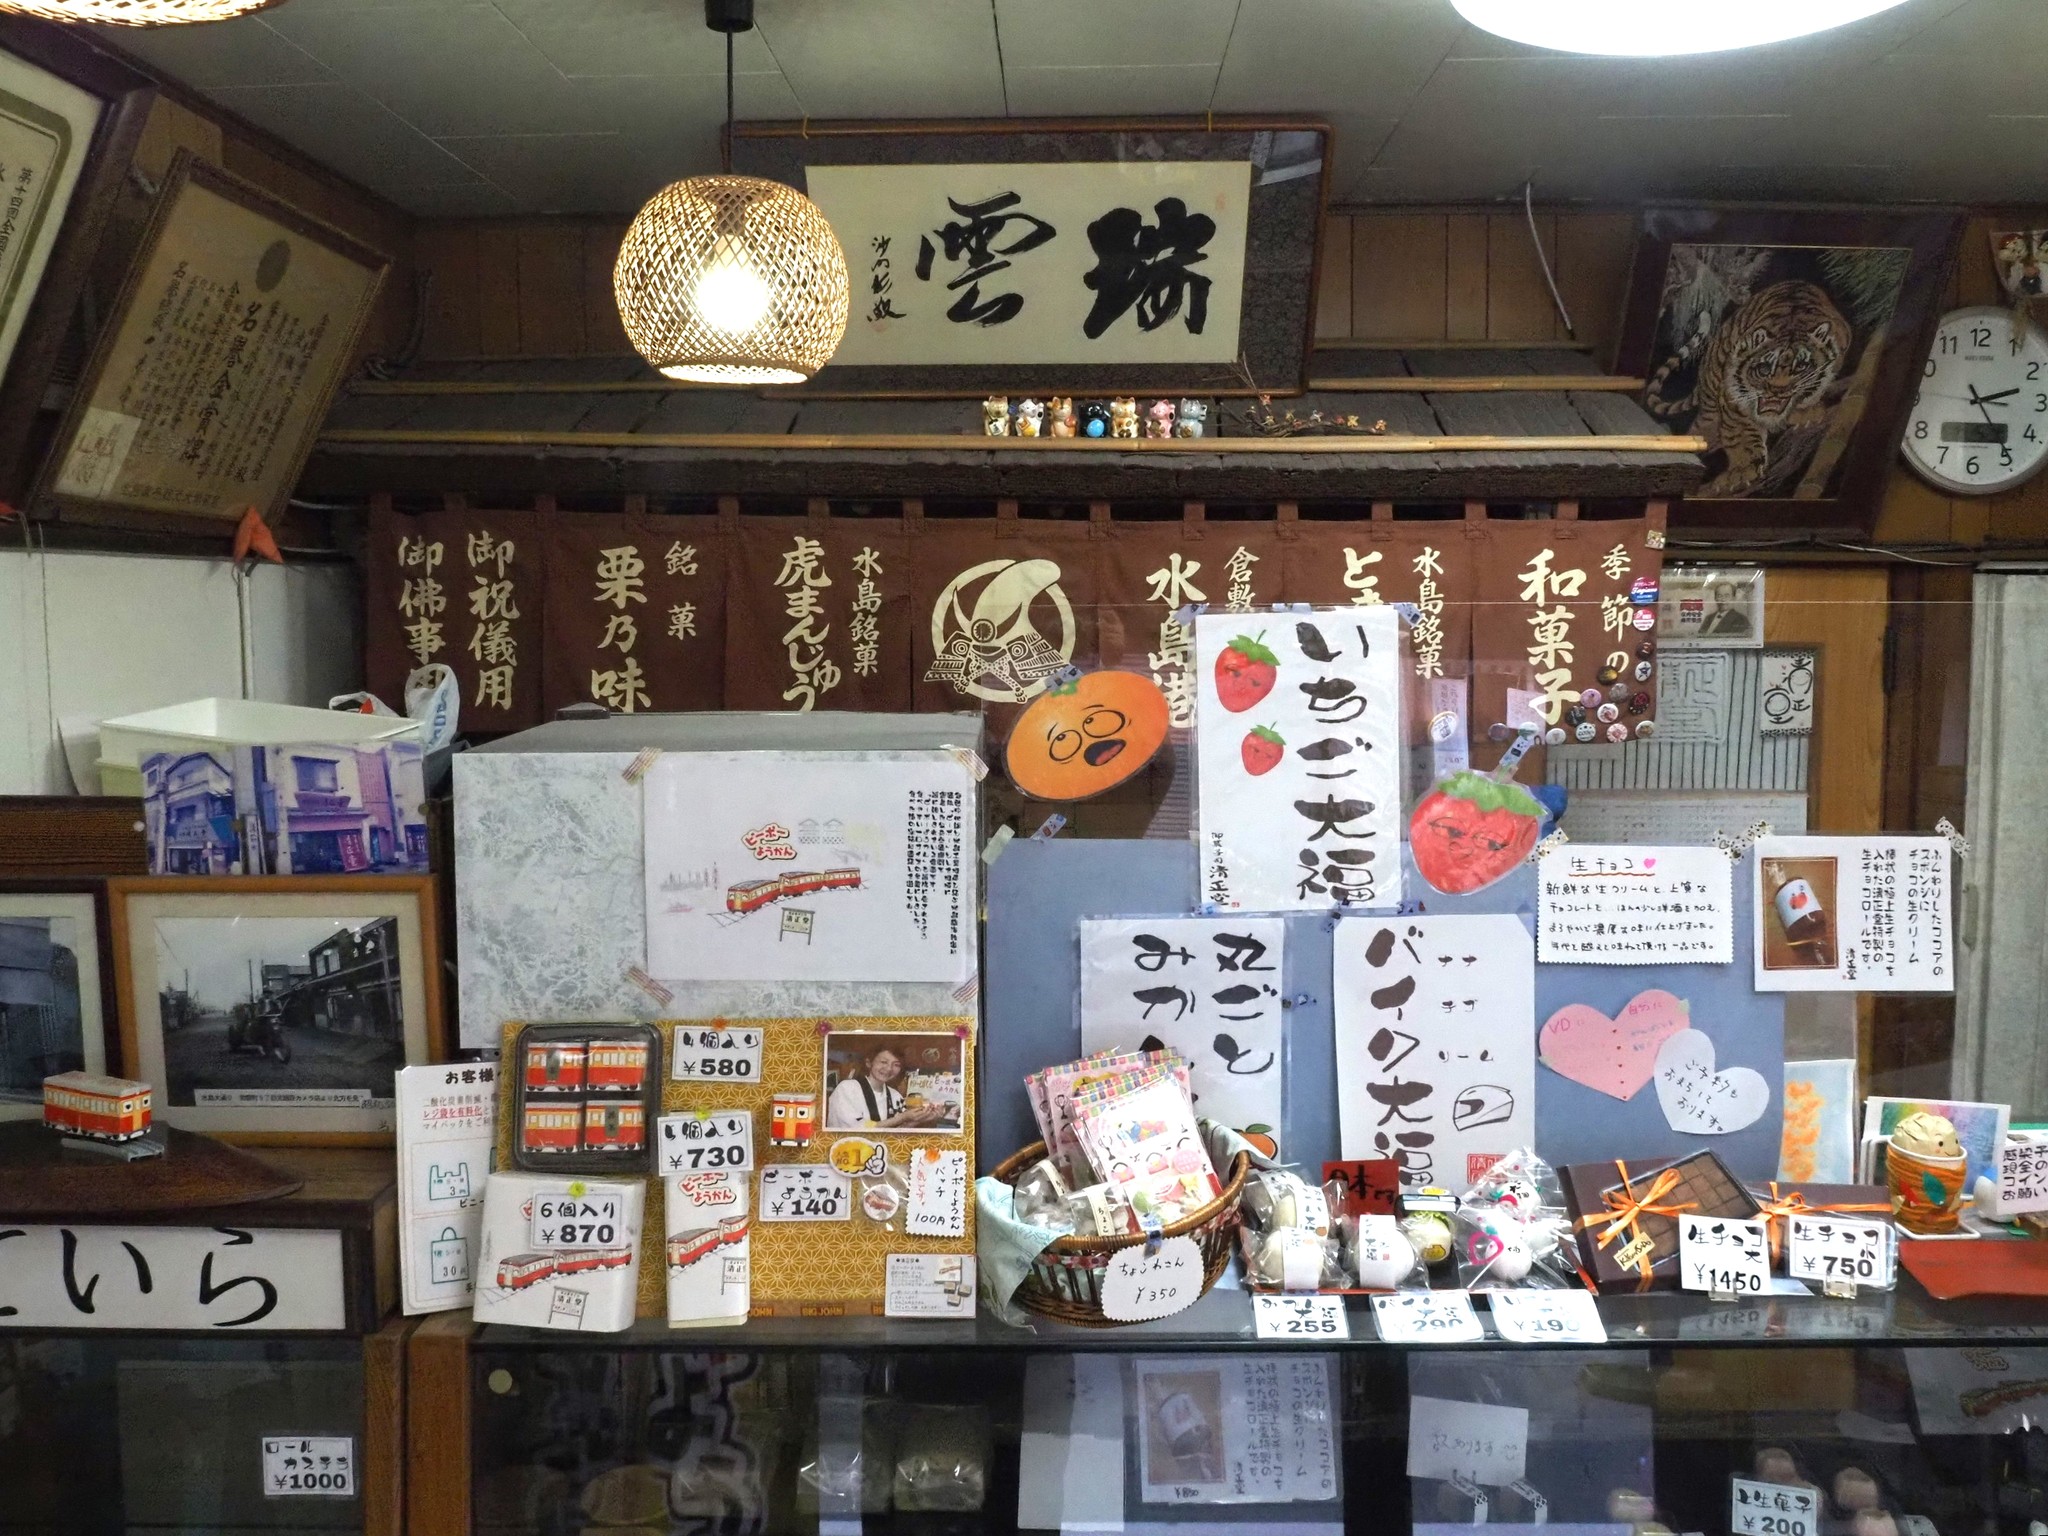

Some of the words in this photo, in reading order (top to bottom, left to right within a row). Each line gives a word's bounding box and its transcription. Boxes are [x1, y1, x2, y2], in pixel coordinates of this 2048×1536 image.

[1939, 335, 1958, 355] 11
[1970, 328, 1991, 347] 12
[2026, 362, 2040, 380] 2
[2035, 393, 2048, 412] 3
[1914, 420, 1929, 439] 8
[2023, 424, 2037, 443] 4
[1937, 446, 1949, 464] 7
[1966, 456, 1979, 475] 6
[664, 540, 699, 641] 銘菓
[849, 546, 884, 676] 水島銘菓
[1411, 546, 1446, 680] 水島銘菓
[1599, 543, 1634, 675] 季節の
[467, 531, 521, 711] 御祝儀用
[591, 545, 652, 714] 栗乃味
[774, 536, 842, 712] 虎まんじゅう
[1518, 549, 1588, 727] 和菓子
[1294, 622, 1377, 902] いちご大福
[1571, 857, 1634, 873] 生チョコ
[1919, 849, 1932, 912] スポンジに
[1907, 850, 1920, 964] チョコの生クリーム
[1931, 850, 1944, 977] ふんわりしたココアの
[1211, 933, 1278, 1075] 丸ごと
[683, 1031, 759, 1049] 4個入り
[1364, 925, 1435, 1186] バイク大福
[445, 1068, 501, 1085] お客様
[683, 1059, 752, 1077] ¥580
[669, 1146, 746, 1169] ¥730
[936, 1166, 946, 1198] バッチ
[2003, 1174, 2047, 1187] コイン
[781, 1187, 849, 1201] ようかん
[2002, 1187, 2047, 1201] お願い
[540, 1202, 616, 1220] 6個入り
[771, 1199, 838, 1217] ¥140
[914, 1213, 946, 1226] 100円
[541, 1224, 616, 1244] ¥870
[1687, 1223, 1764, 1246] 生チョコ
[1794, 1221, 1880, 1246] 生チョコ
[1744, 1250, 1762, 1263] 大
[1860, 1243, 1876, 1260] 小
[1802, 1255, 1874, 1277] ¥750
[1693, 1262, 1762, 1292] ¥1450
[1135, 1286, 1178, 1305] ¥350
[1270, 1319, 1337, 1333] ¥255
[265, 1440, 313, 1454] ロール
[275, 1473, 347, 1491] ¥1000
[1742, 1514, 1806, 1536] ¥200
